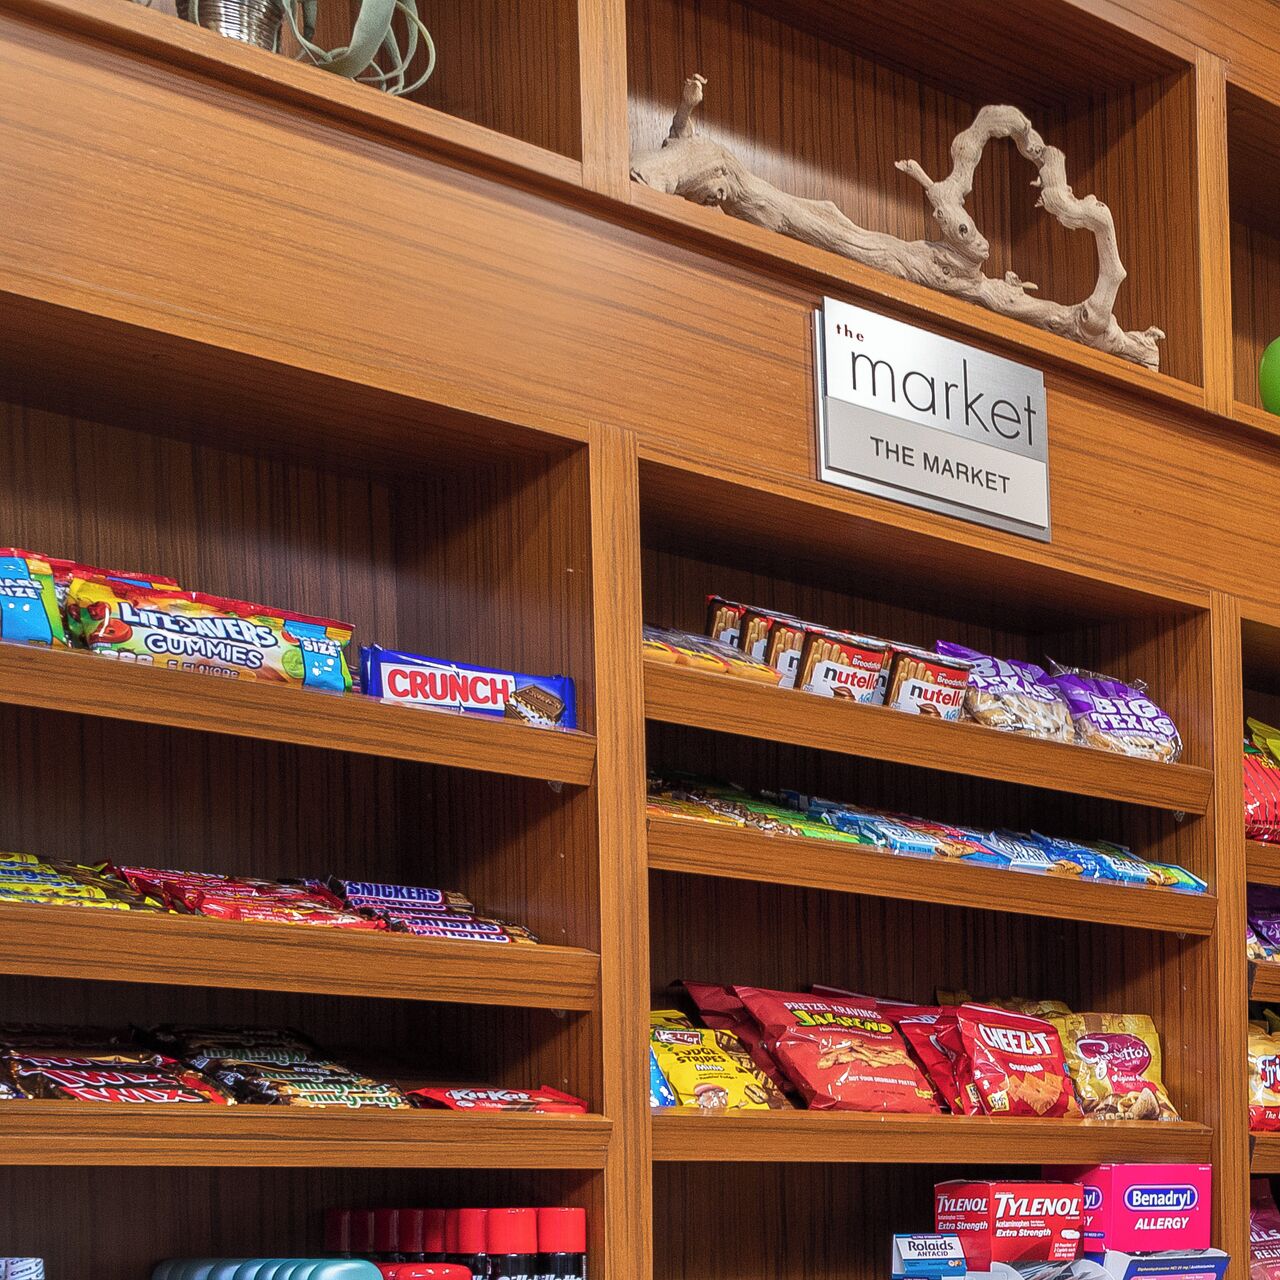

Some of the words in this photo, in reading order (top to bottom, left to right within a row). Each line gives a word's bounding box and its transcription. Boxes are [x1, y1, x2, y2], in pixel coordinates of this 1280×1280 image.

[836, 324, 864, 342] the
[851, 352, 1036, 446] market
[870, 436, 915, 466] THE
[923, 452, 1010, 494] MARKET
[146, 633, 264, 669] GUMMIES
[303, 640, 339, 657] SIZE
[387, 668, 510, 706] CRUNCH
[1093, 693, 1158, 719] BIG
[1090, 713, 1176, 736] TEXAS
[347, 882, 440, 903] SNICKERS
[784, 1002, 831, 1012] PRETZEL
[831, 1005, 882, 1019] KRAVINGS
[676, 1055, 726, 1063] STRIPES
[1265, 1111, 1276, 1119] The
[937, 1194, 988, 1213] TYLENOL
[995, 1194, 1080, 1218] TYLENOL
[1132, 1190, 1190, 1208] Benadryl
[938, 1221, 955, 1229] Extra
[956, 1221, 988, 1231] Strength
[996, 1219, 1030, 1228] Acetaminophen
[1135, 1216, 1189, 1230] ALLERGY
[996, 1228, 1021, 1238] Extra
[1022, 1228, 1052, 1238] Strength
[908, 1241, 954, 1252] Rolaids
